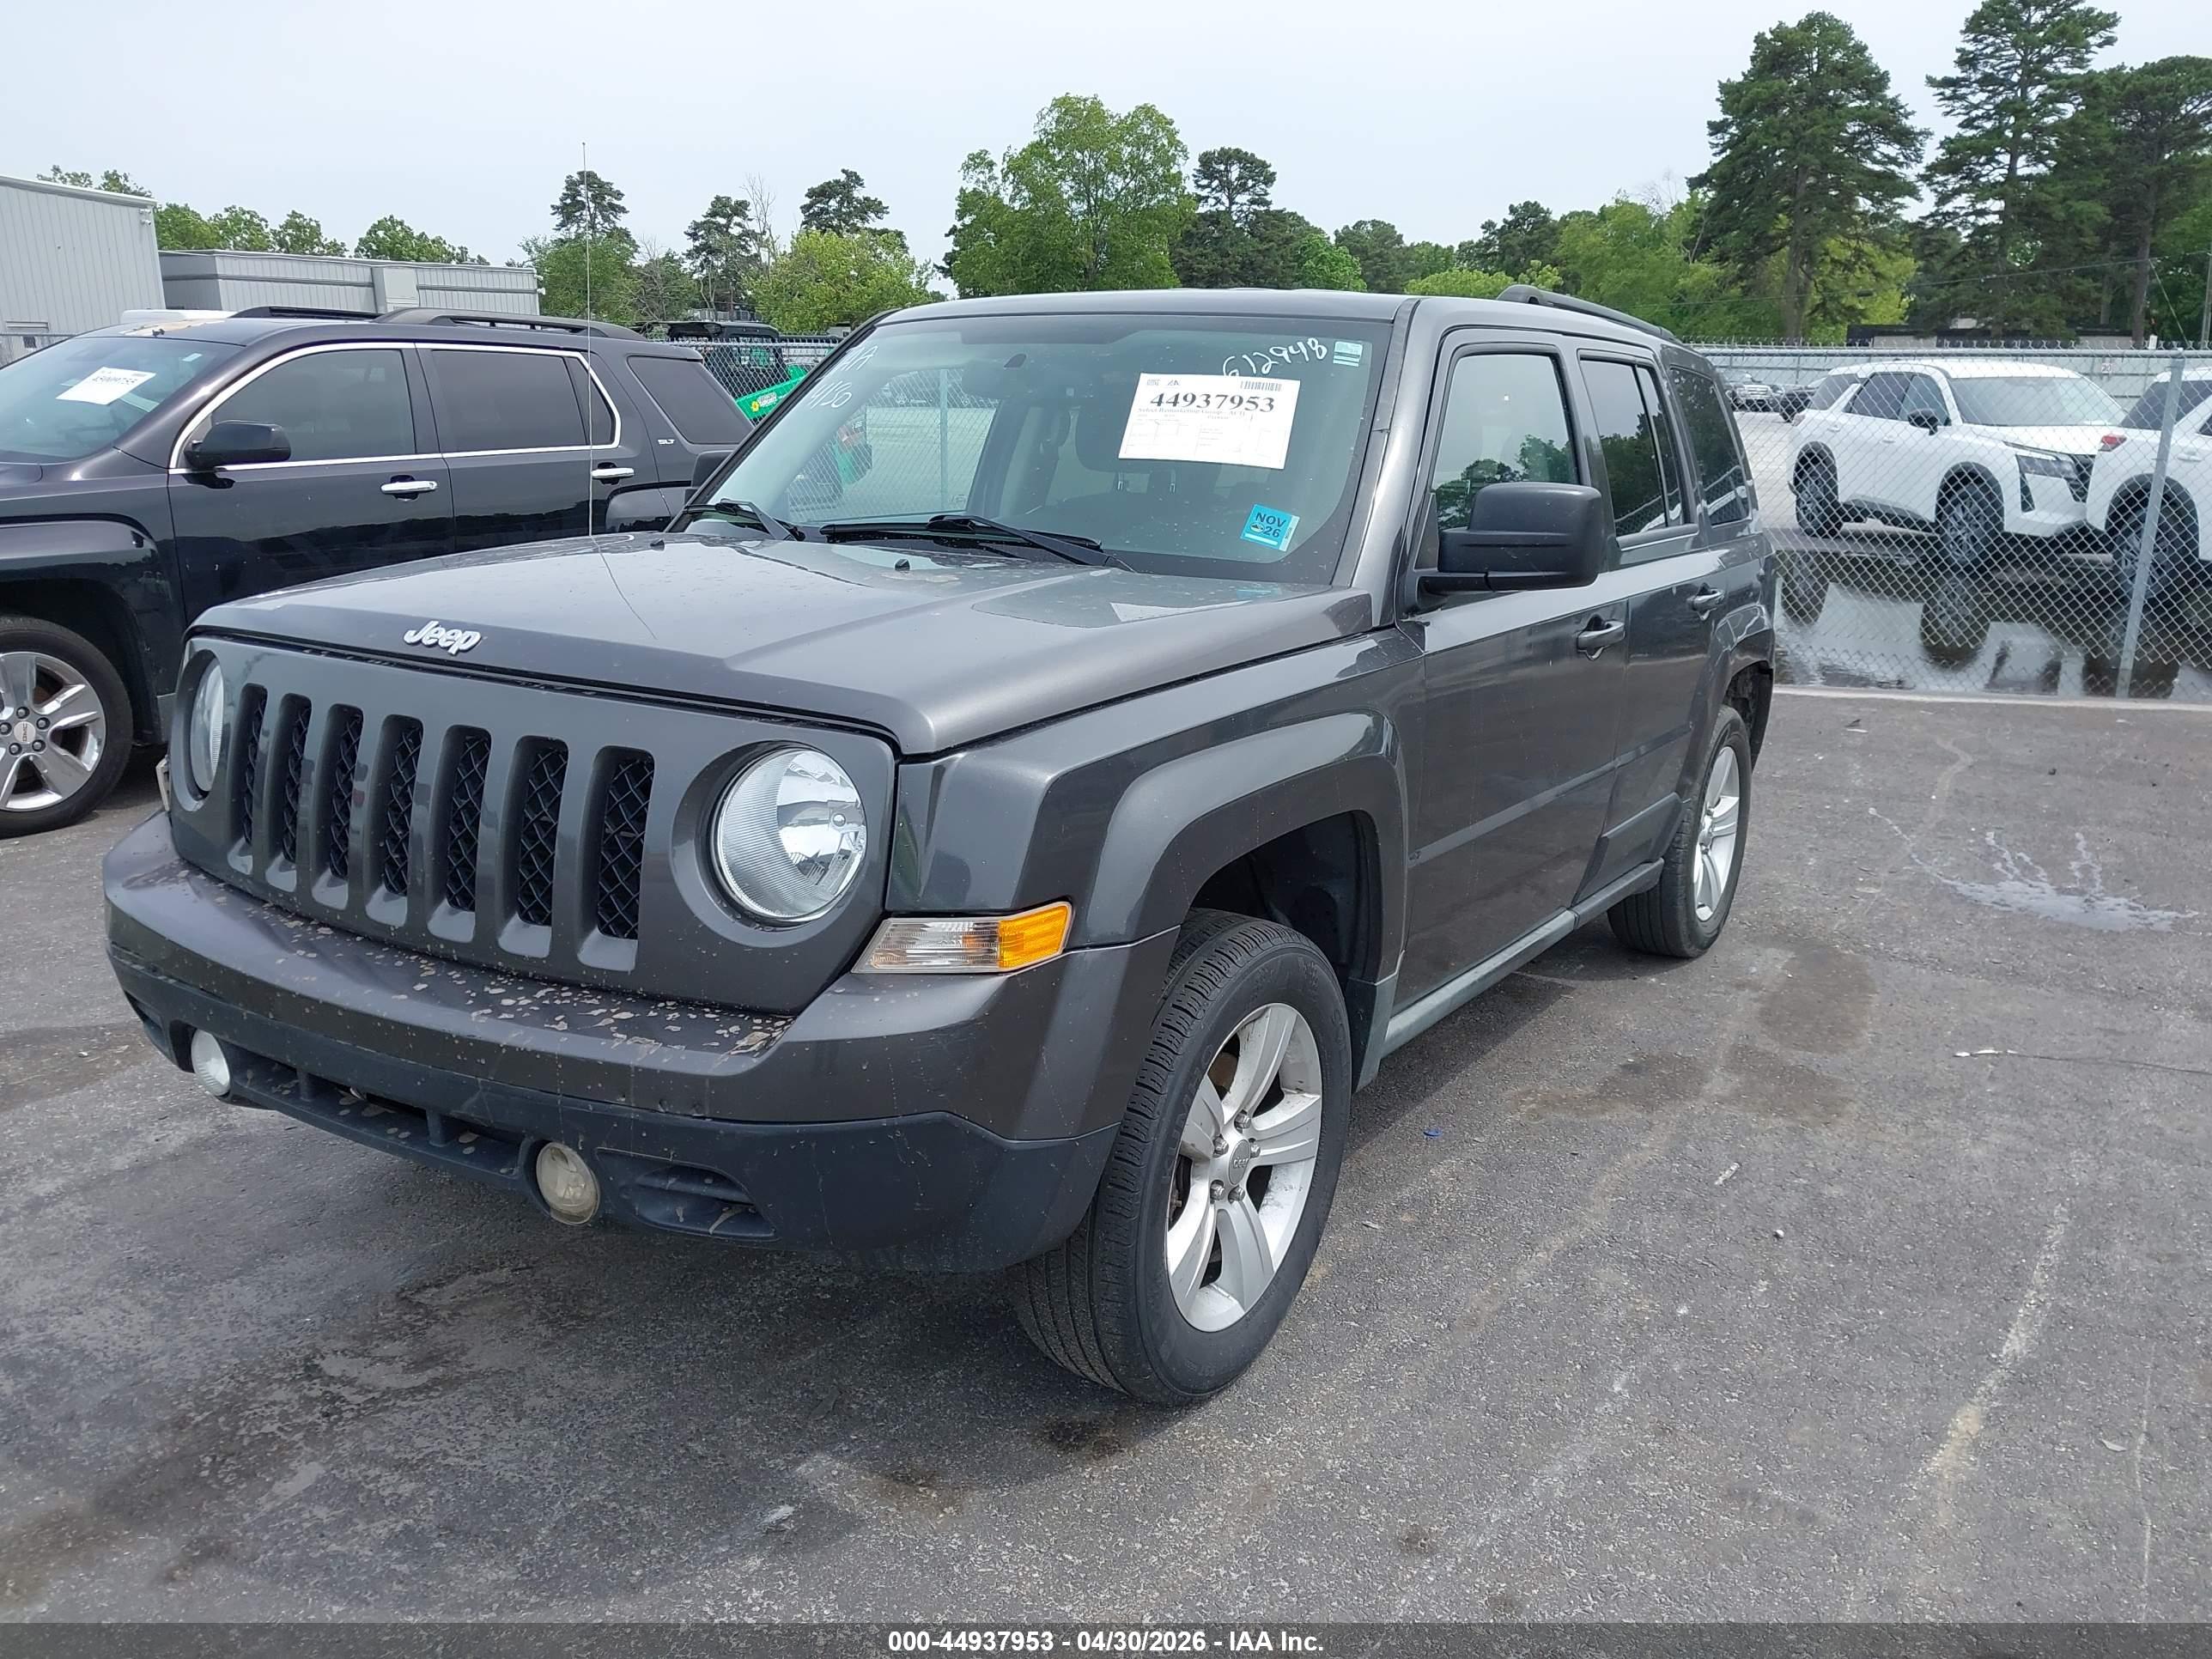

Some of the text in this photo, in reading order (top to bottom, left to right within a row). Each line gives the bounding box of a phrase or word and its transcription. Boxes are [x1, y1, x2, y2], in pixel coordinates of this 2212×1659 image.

[1150, 392, 1275, 413] 44937953
[1255, 512, 1286, 528] NOV
[1263, 526, 1281, 538] 26
[404, 620, 482, 655] Jeep
